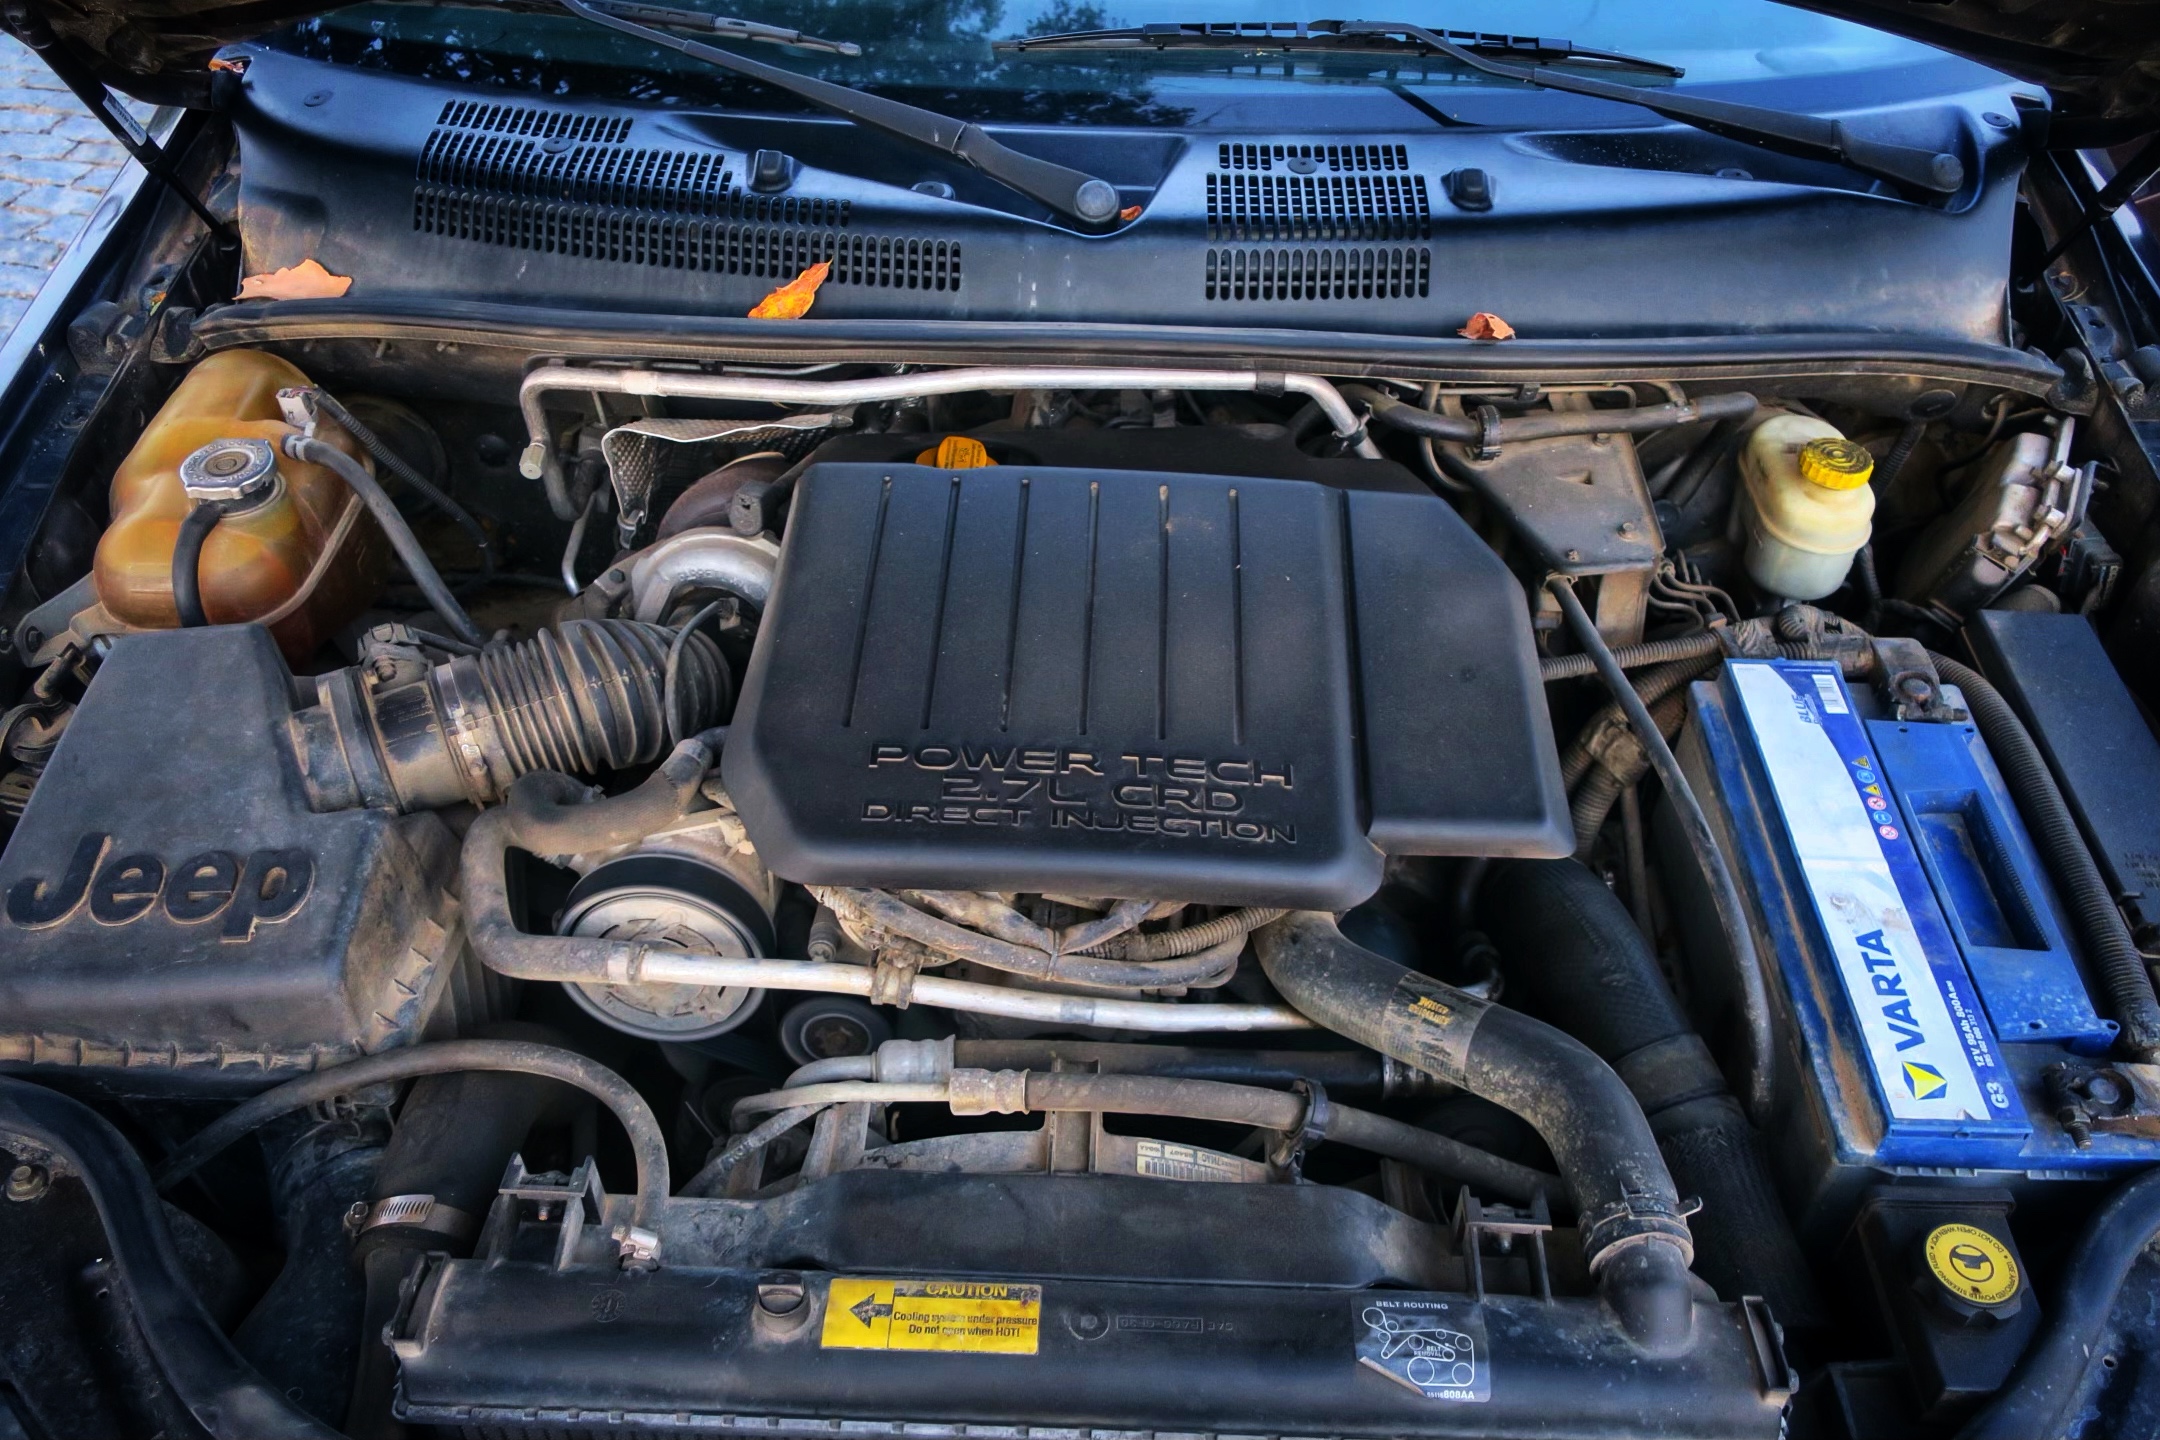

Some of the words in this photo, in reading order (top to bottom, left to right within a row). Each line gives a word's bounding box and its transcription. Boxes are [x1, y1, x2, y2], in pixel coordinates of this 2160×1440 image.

[1792, 694, 1813, 724] BLUE
[869, 743, 1104, 776] POWER
[1122, 752, 1294, 788] TECH
[942, 773, 1088, 805] 2.7L
[1112, 783, 1245, 816] CRD
[861, 803, 1031, 827] DIRECT
[1050, 808, 1297, 844] INJECTION
[6, 831, 316, 944] Jeep
[1855, 929, 1926, 1052] VARTA
[1960, 1019, 1977, 1046] 95Ah
[1970, 1047, 1985, 1067] 12V
[1986, 1081, 2010, 1109] G3
[1978, 1232, 1993, 1244] NOT
[926, 1283, 1008, 1297] CAUTION
[893, 1311, 930, 1323] Cooling
[967, 1314, 995, 1323] under
[996, 1316, 1037, 1325] pressure
[1403, 1302, 1449, 1310] ROUTING
[908, 1323, 921, 1334] Do
[924, 1324, 940, 1335] not
[968, 1327, 994, 1337] when
[996, 1328, 1020, 1338] HOT!
